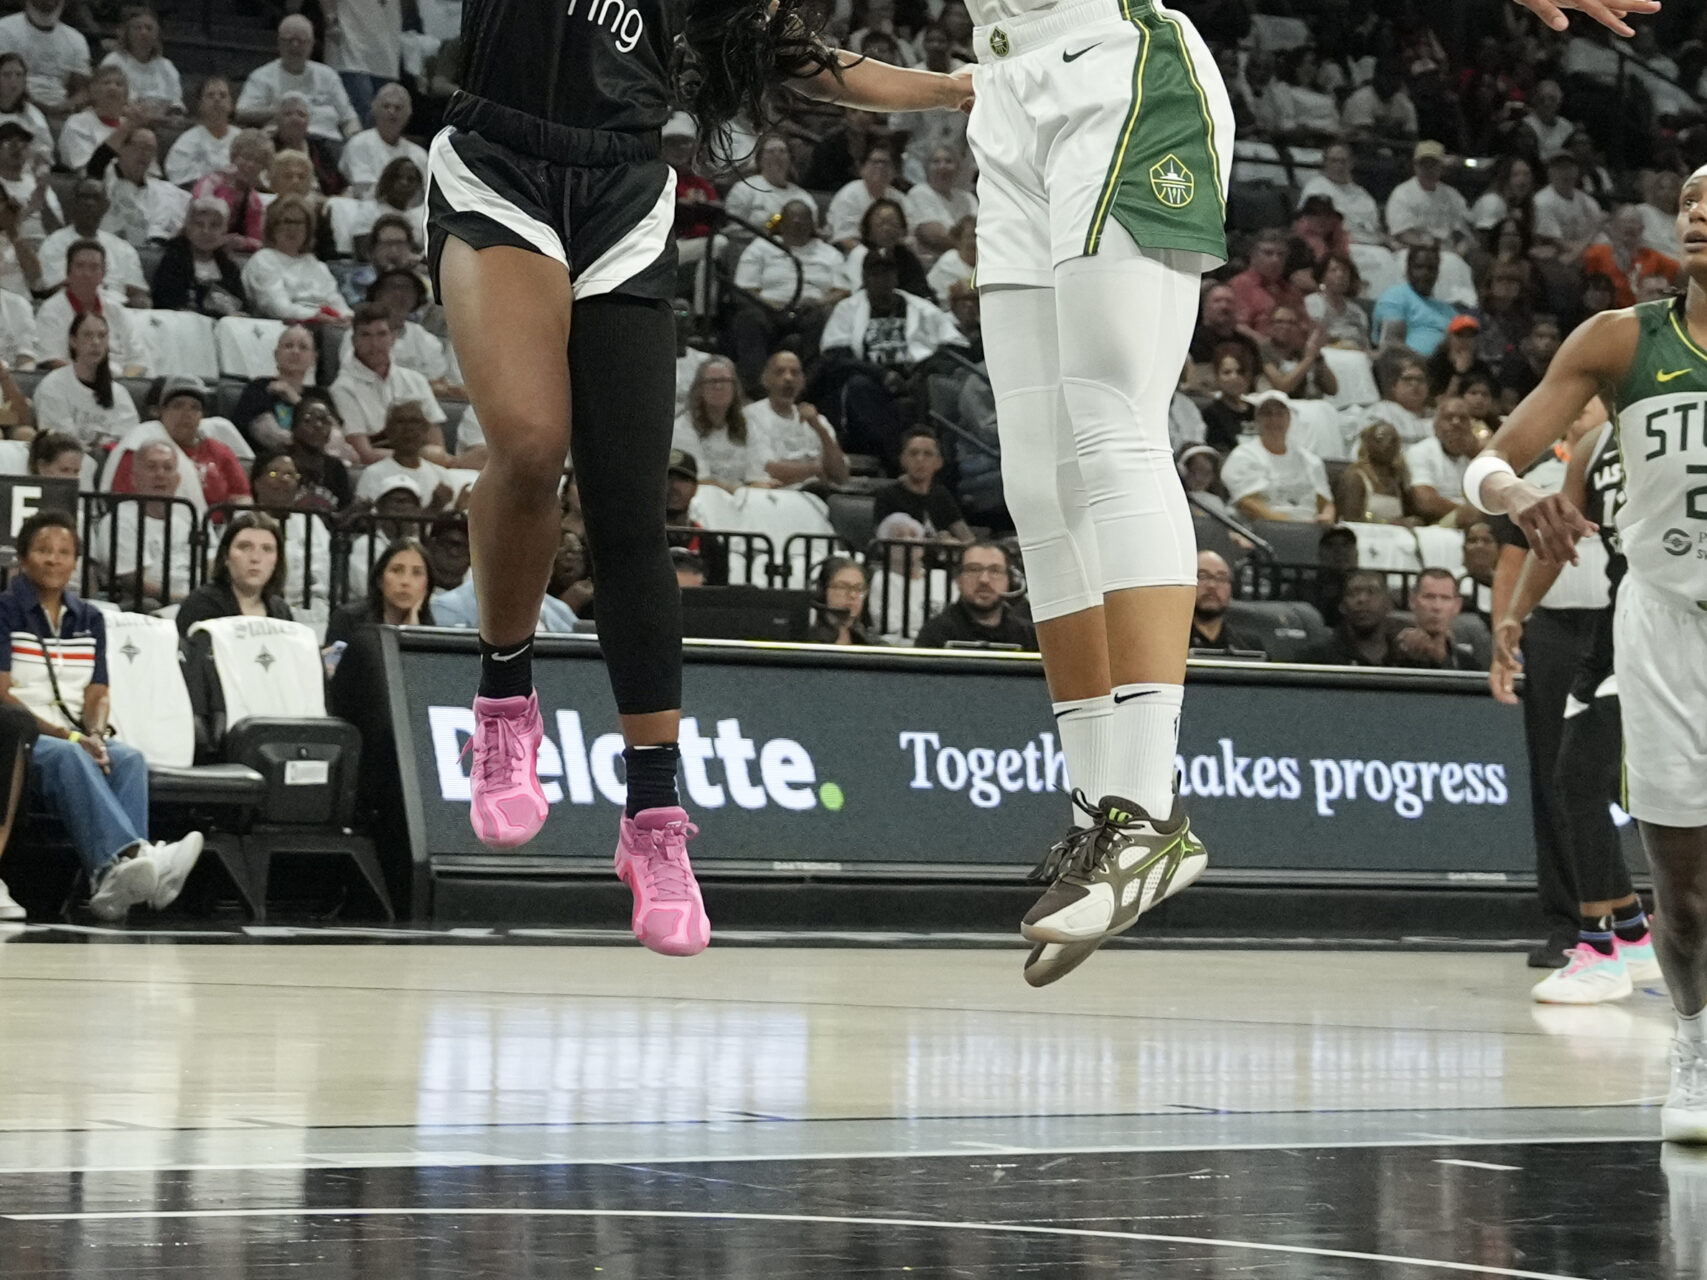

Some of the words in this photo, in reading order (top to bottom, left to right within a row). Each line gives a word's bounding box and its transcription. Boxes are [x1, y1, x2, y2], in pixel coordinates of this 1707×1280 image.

[1645, 400, 1707, 461] ST
[900, 730, 1066, 808] Togeth
[1311, 755, 1509, 820] progress
